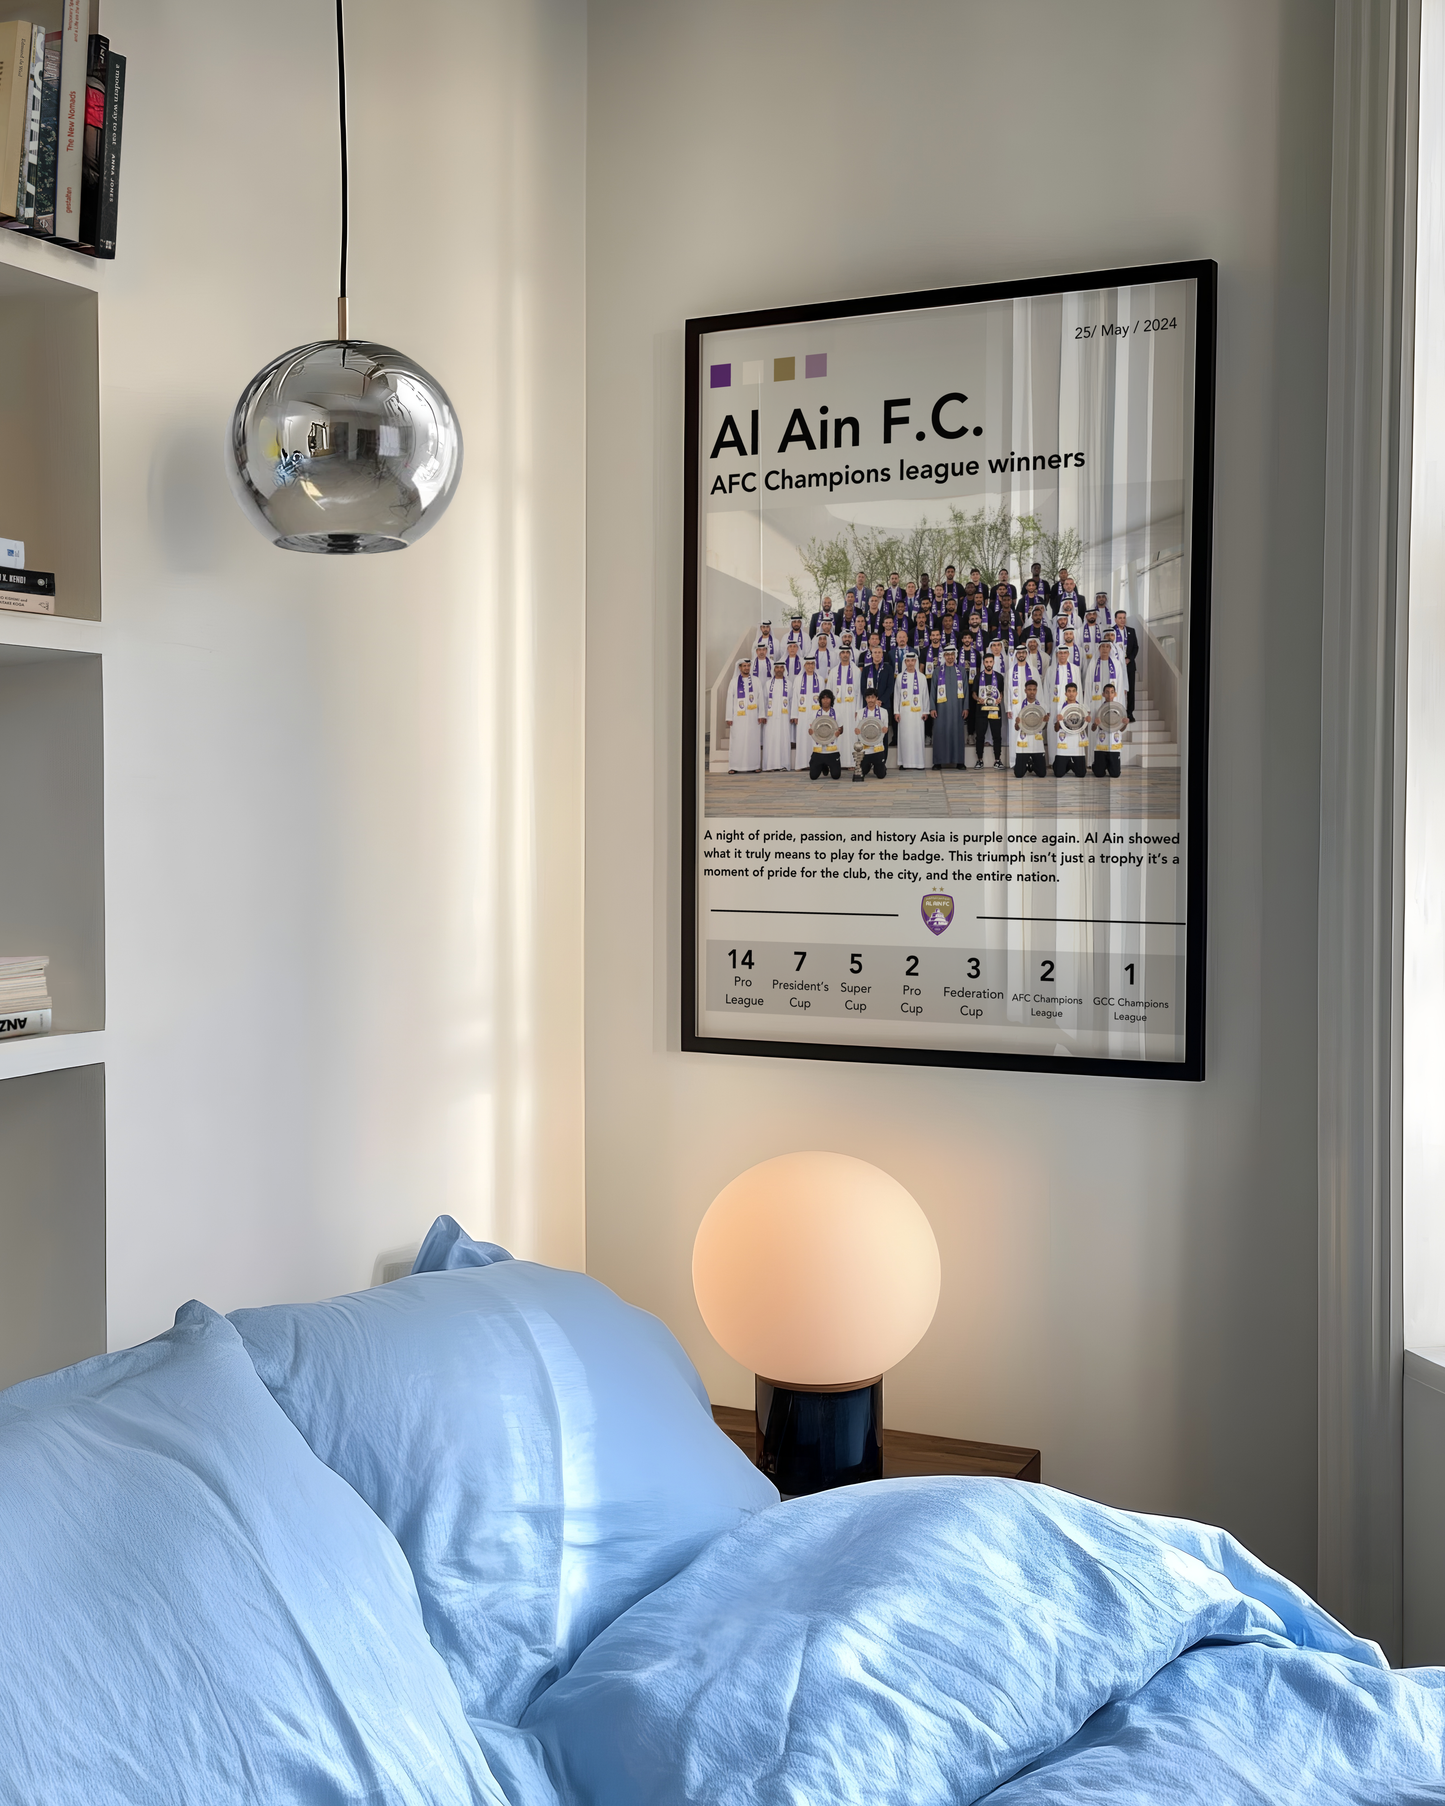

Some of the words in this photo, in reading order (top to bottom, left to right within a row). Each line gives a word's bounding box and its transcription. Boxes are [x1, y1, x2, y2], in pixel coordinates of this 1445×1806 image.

[113, 70, 121, 102] modern
[68, 90, 77, 120] Nomads
[67, 121, 75, 138] New
[112, 122, 118, 131] to
[66, 138, 75, 152] The
[65, 186, 73, 214] gestalten
[1074, 325, 1098, 340] 25/
[1101, 323, 1130, 338] May
[1133, 320, 1140, 334] /
[1143, 317, 1178, 332] 2024
[709, 409, 760, 460] Al
[777, 404, 861, 454] Ain
[882, 391, 984, 445] F.C.
[710, 473, 758, 495] AFC
[764, 464, 892, 493] Champions
[899, 458, 980, 485] league
[987, 450, 1086, 475] winners
[2, 573, 8, 582] X.
[9, 574, 26, 584] KENDI
[703, 829, 713, 841] A
[716, 829, 745, 843] night
[748, 829, 760, 841] of
[763, 830, 797, 844] pride,
[800, 831, 847, 845] passion,
[850, 830, 872, 842] and
[876, 830, 917, 845] history
[920, 831, 946, 843] Asia
[949, 831, 959, 843] is
[963, 831, 1003, 846] purple
[1007, 834, 1038, 844] once
[1041, 832, 1080, 847] again.
[1084, 832, 1098, 844] Al
[1102, 832, 1124, 844] Ain
[1128, 832, 1180, 845] showed
[703, 847, 731, 859] what
[734, 848, 742, 859] it
[745, 848, 772, 862] truly
[774, 851, 811, 860] means
[814, 850, 827, 860] to
[830, 849, 855, 863] play
[858, 849, 876, 861] for
[879, 849, 899, 861] the
[902, 849, 945, 864] badge.
[949, 850, 973, 862] This
[976, 851, 1026, 863] triumph
[1030, 851, 1057, 863] isn’t
[1060, 851, 1084, 866] just
[1088, 854, 1096, 864] a
[1099, 852, 1144, 867] trophy
[1147, 852, 1168, 865] it’s
[1172, 855, 1180, 865] a
[703, 867, 749, 878] moment
[752, 866, 765, 878] of
[767, 867, 797, 880] pride
[800, 867, 817, 879] for
[820, 868, 840, 879] the
[843, 868, 871, 881] club,
[874, 868, 894, 880] the
[897, 869, 922, 883] city,
[925, 869, 949, 881] and
[952, 869, 972, 881] the
[976, 870, 1013, 882] entire
[1016, 870, 1060, 883] nation.
[728, 949, 755, 970] 14
[793, 951, 807, 972] 7
[849, 953, 863, 974] 5
[905, 955, 920, 976] 2
[966, 957, 981, 979] 3
[1040, 960, 1055, 982] 2
[1124, 963, 1135, 985] 1
[734, 976, 752, 988] Pro
[772, 979, 830, 992] President’s
[840, 982, 872, 996] Super
[903, 985, 922, 996] Pro
[943, 987, 1004, 1000] Federation
[725, 994, 765, 1009] League
[789, 997, 812, 1011] Cup
[845, 1000, 867, 1014] Cup
[1012, 994, 1031, 1003] AFC
[1033, 994, 1083, 1006] Champions
[1093, 997, 1115, 1007] GCC
[1117, 998, 1169, 1010] Champions
[900, 1003, 924, 1017] Cup
[959, 1005, 984, 1020] Cup
[1030, 1008, 1064, 1020] League
[1113, 1012, 1148, 1024] League
